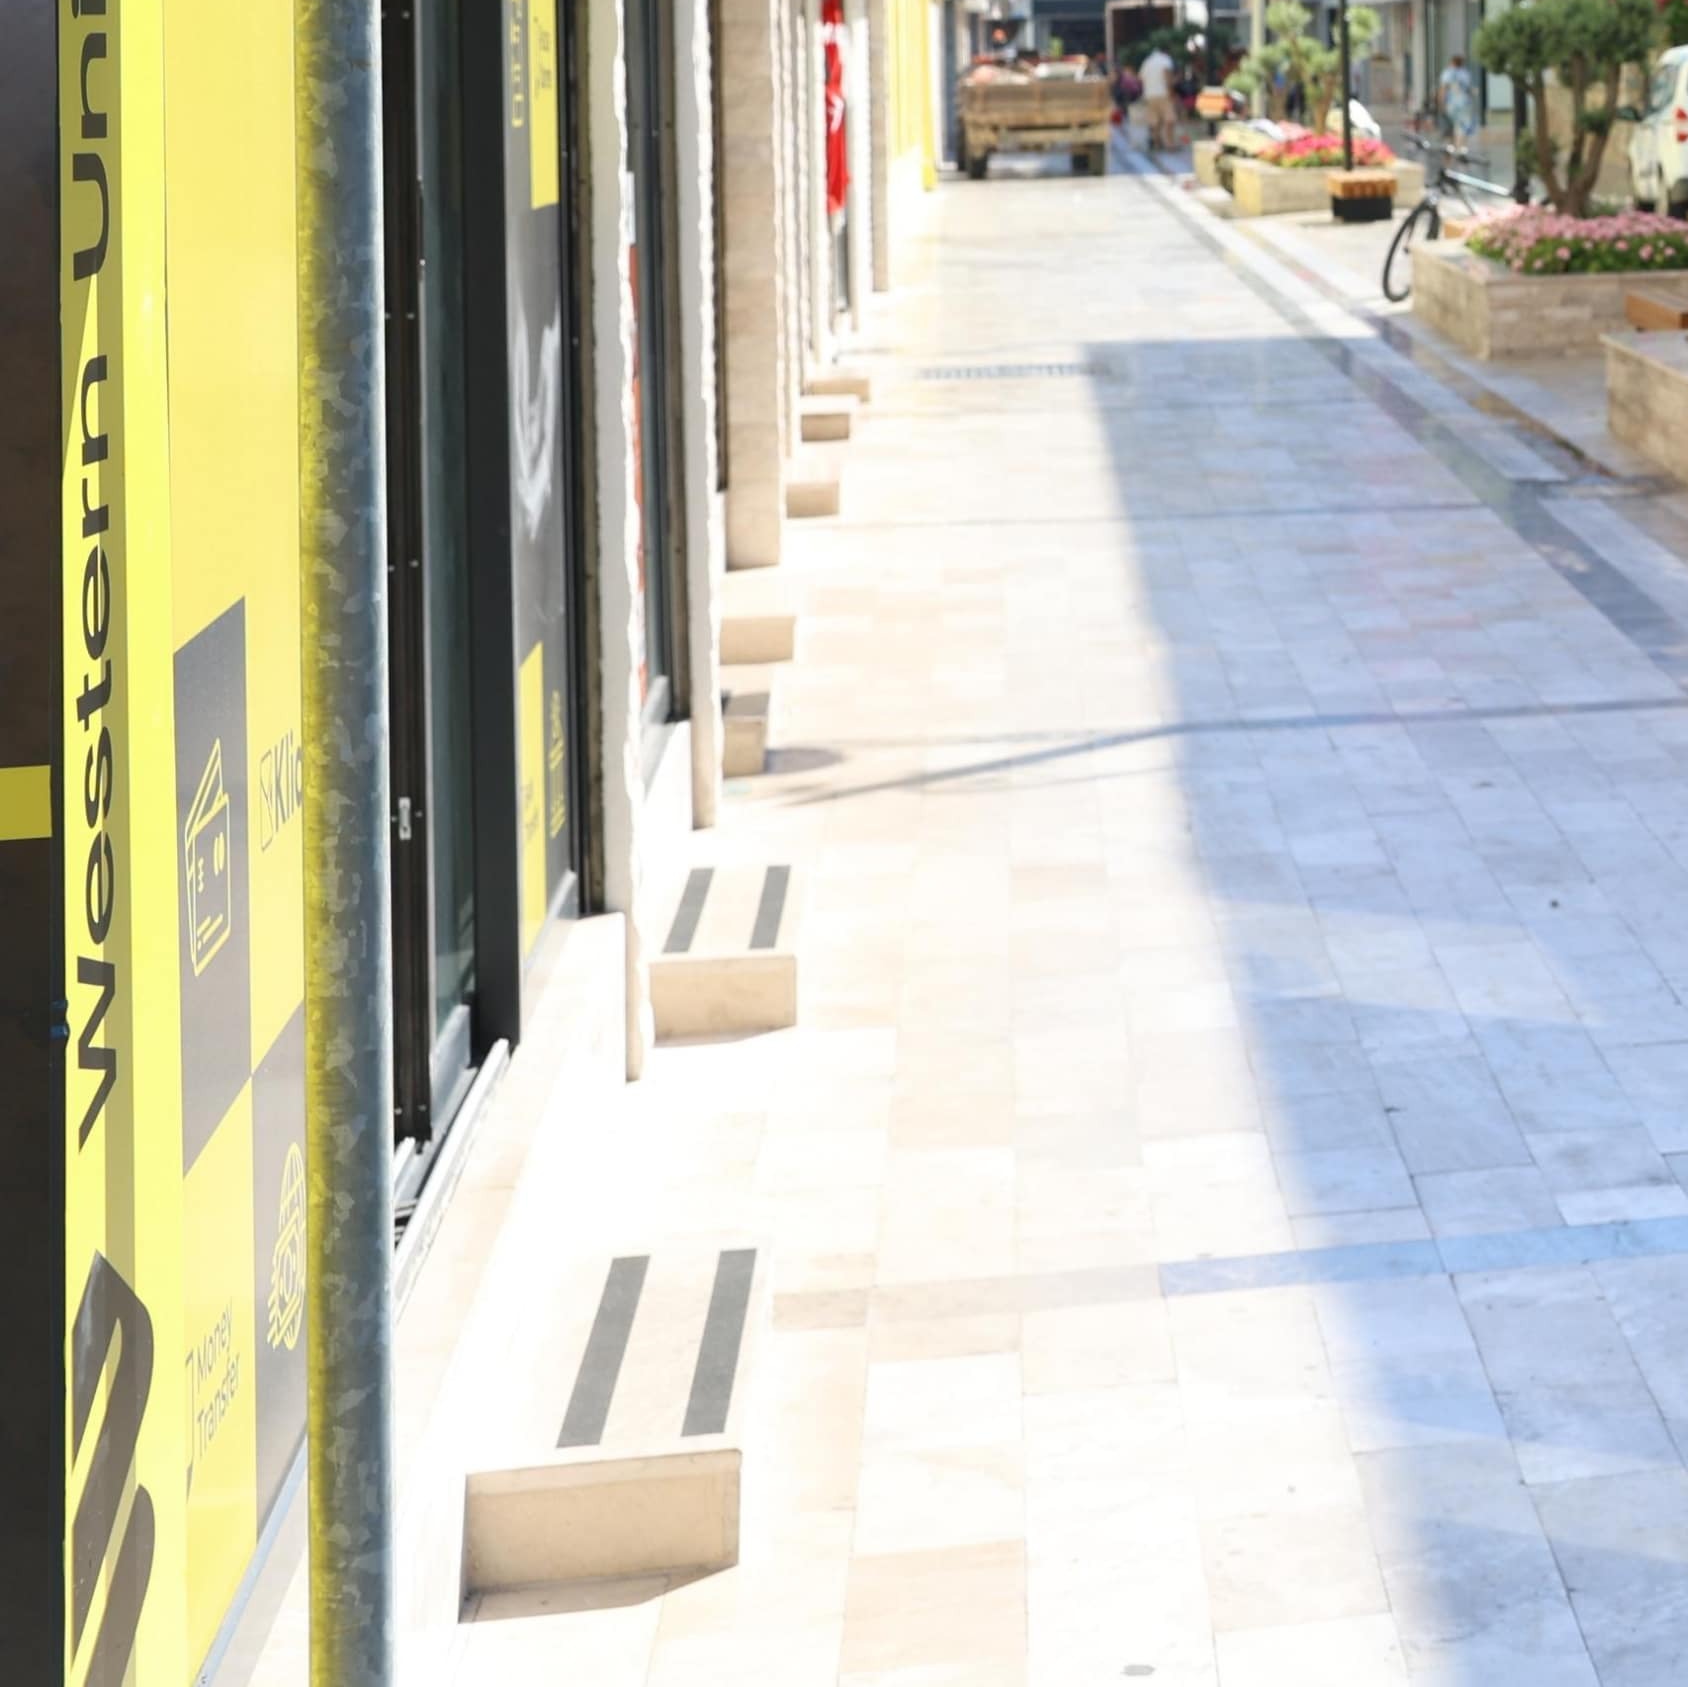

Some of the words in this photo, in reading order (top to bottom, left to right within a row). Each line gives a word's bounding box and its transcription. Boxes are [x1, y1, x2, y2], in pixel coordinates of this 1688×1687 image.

[75, 353, 118, 1154] Western
[197, 1296, 233, 1394] Money
[197, 1352, 240, 1460] Transfer
